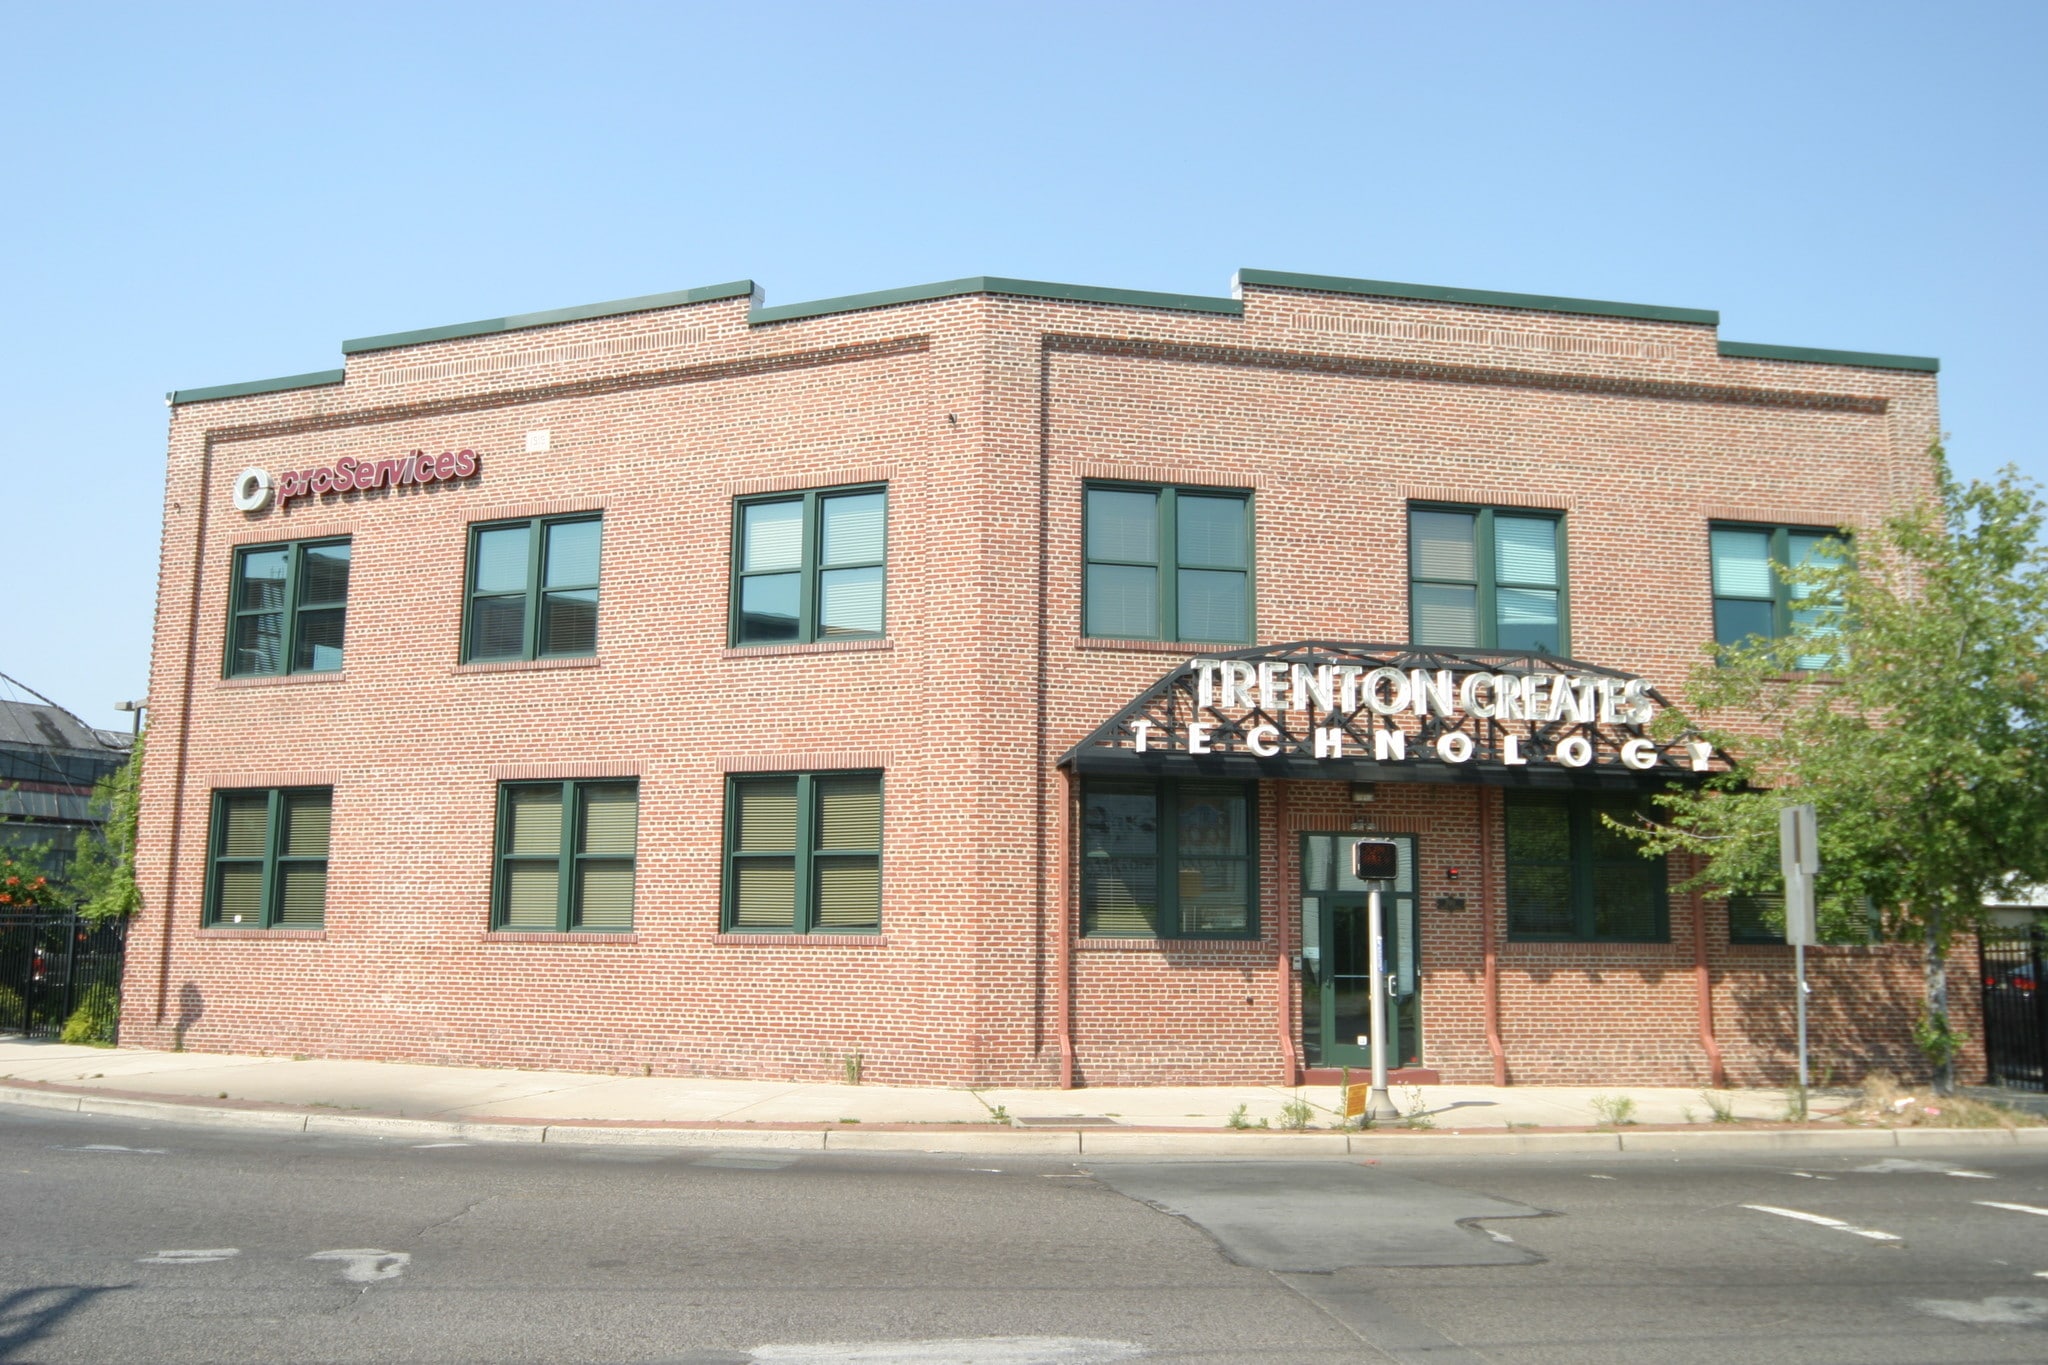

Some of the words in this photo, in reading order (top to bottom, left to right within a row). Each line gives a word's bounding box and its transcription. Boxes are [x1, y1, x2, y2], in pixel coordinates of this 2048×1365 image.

[275, 449, 478, 505] proServices
[1190, 658, 1453, 717] TRENTON
[1460, 671, 1654, 725] CREATES
[1130, 719, 1713, 772] TECHNOLOGY
